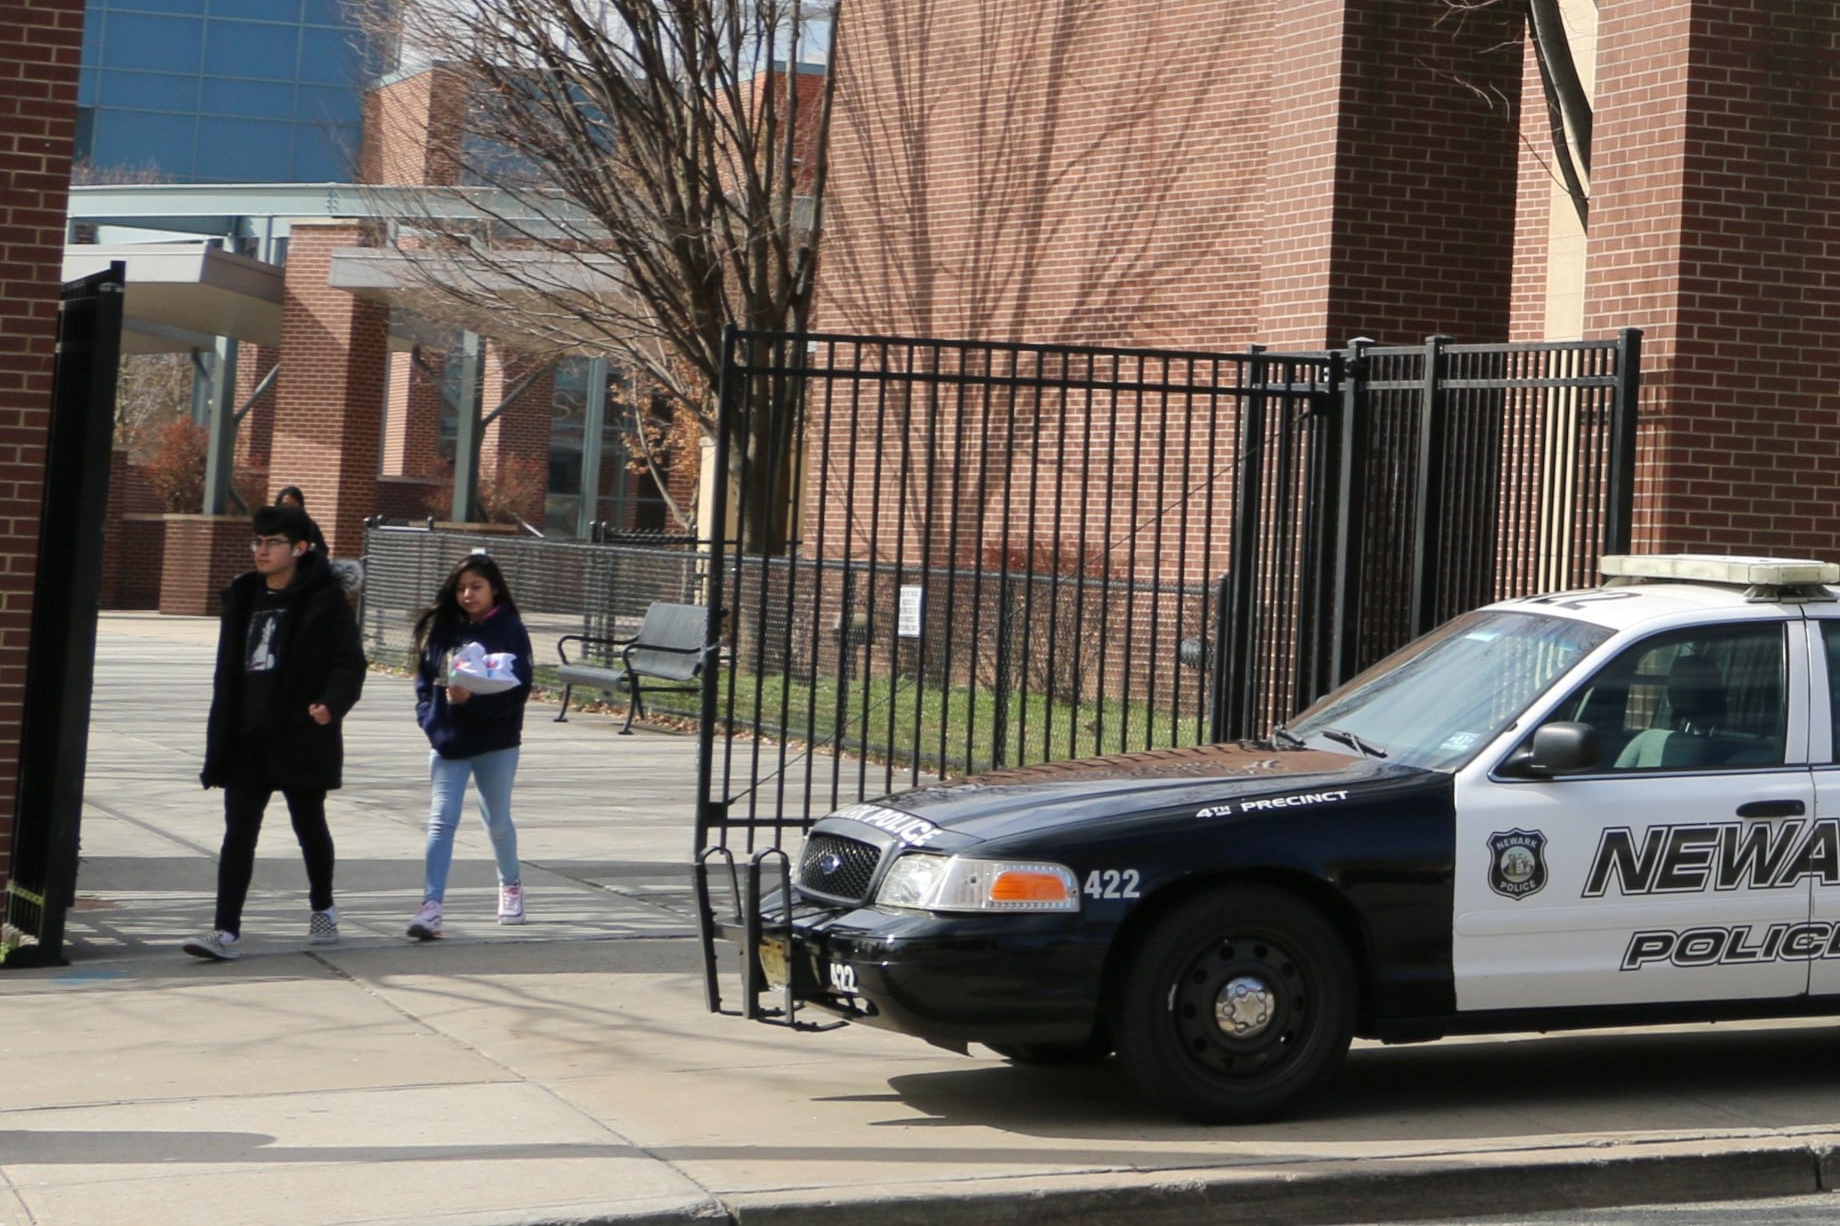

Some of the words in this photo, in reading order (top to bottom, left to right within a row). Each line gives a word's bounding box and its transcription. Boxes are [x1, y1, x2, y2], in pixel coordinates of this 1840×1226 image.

[1196, 805, 1232, 818] 4TH
[1240, 790, 1349, 812] PRECINCT
[863, 808, 943, 847] POLICE
[1496, 837, 1538, 851] NEWARK
[1084, 869, 1141, 899] 422
[1500, 879, 1537, 892] POLICE
[830, 962, 859, 993] 422
